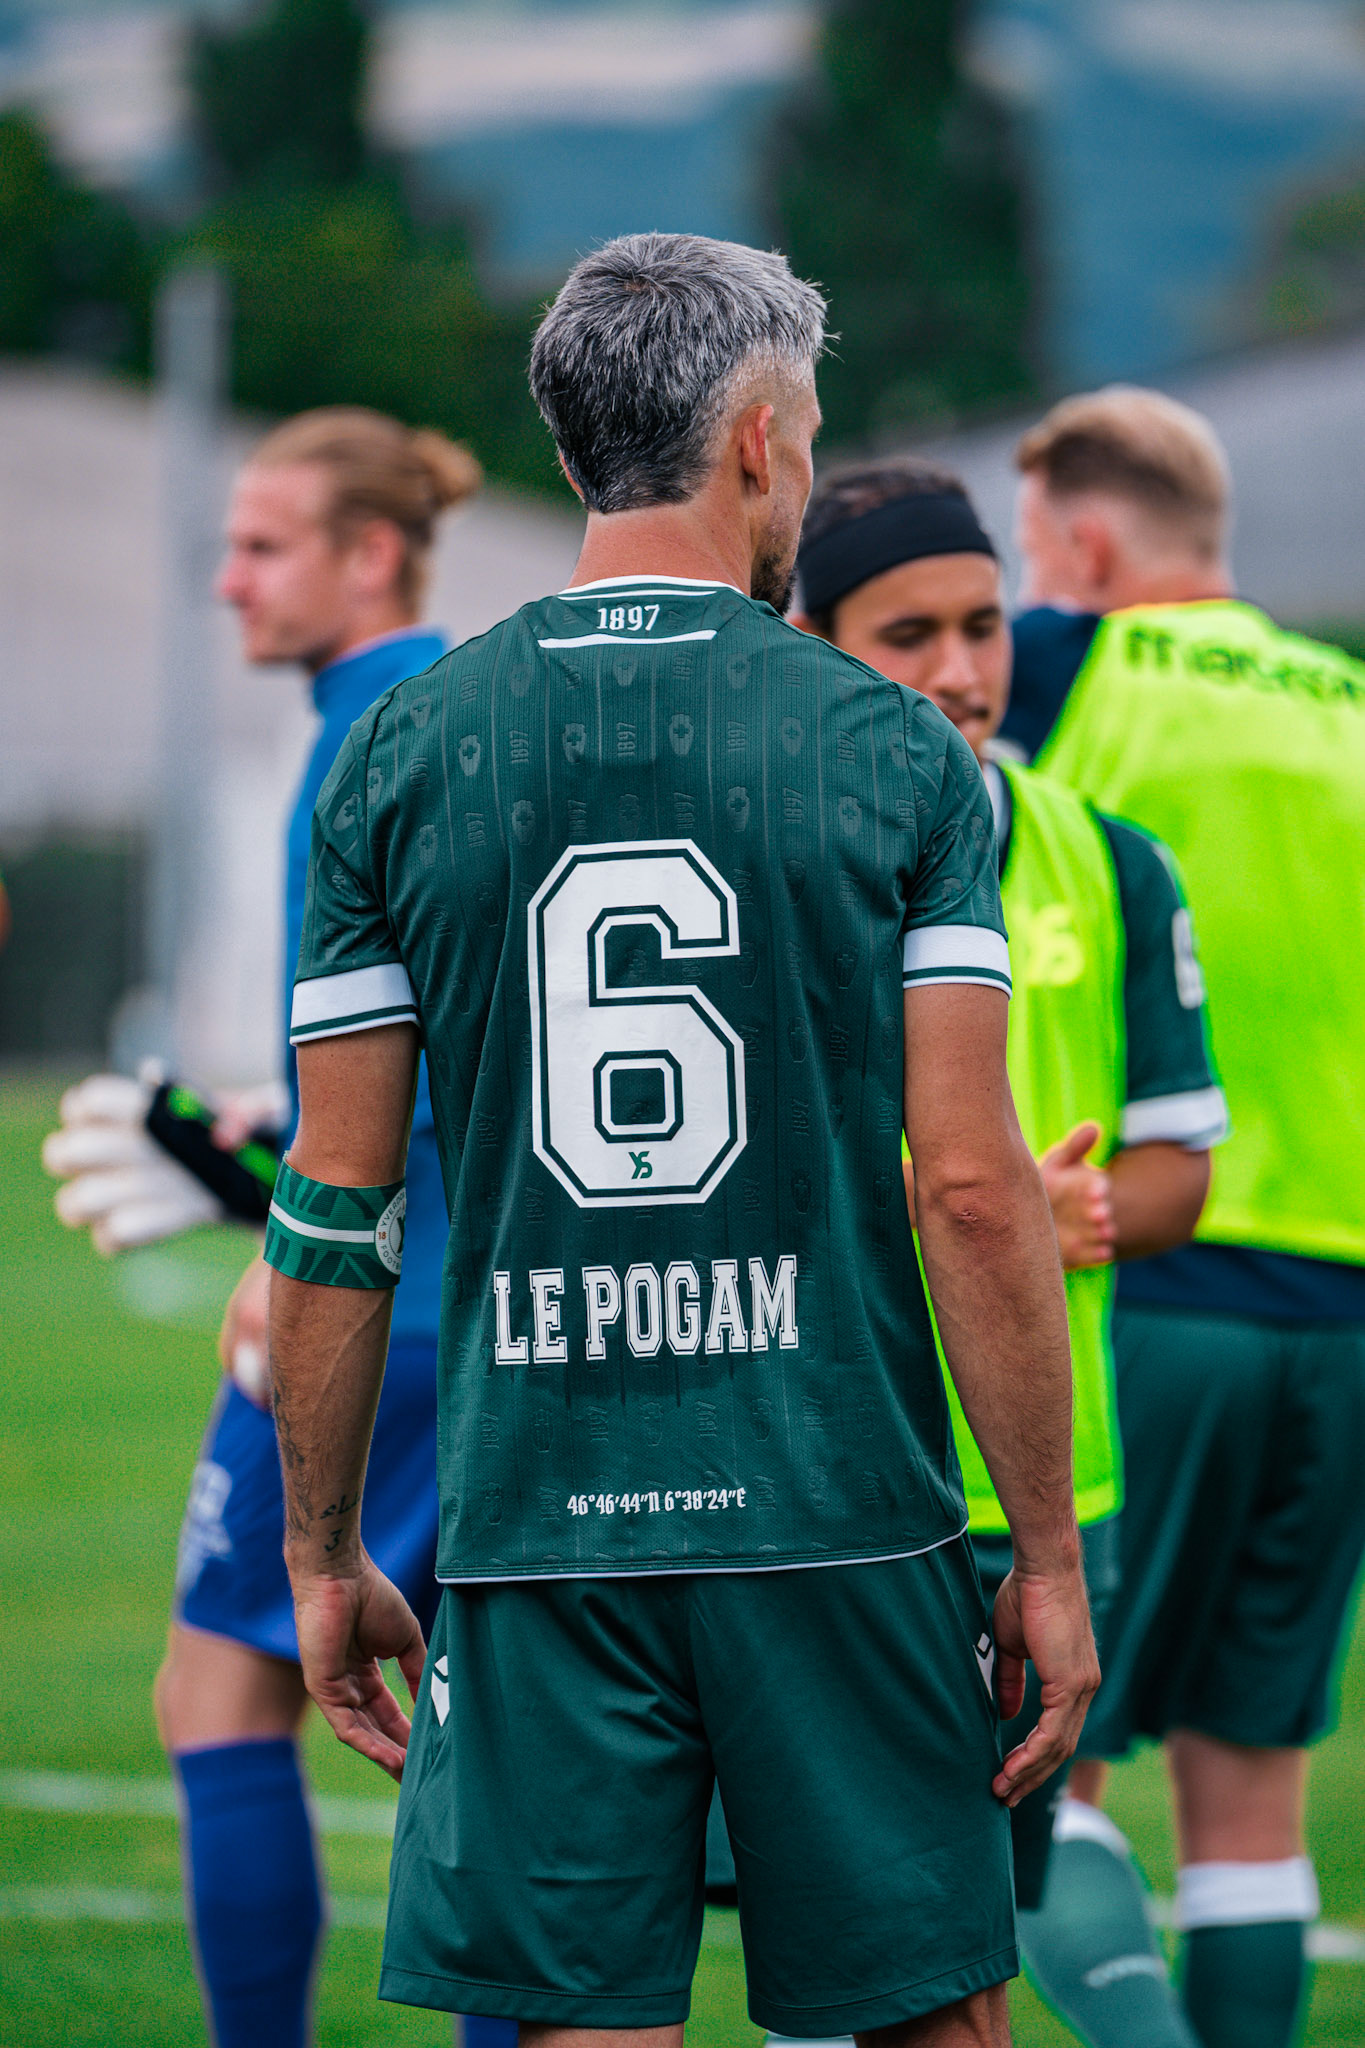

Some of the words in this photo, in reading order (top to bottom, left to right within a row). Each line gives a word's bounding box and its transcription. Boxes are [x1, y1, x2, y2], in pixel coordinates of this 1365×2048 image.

[596, 603, 661, 632] 1897
[509, 729, 529, 765] 1897
[617, 722, 636, 758] 1897
[727, 720, 747, 752] 1897
[526, 838, 748, 1209] 6
[493, 1268, 568, 1365] LE
[582, 1254, 799, 1361] POGAM
